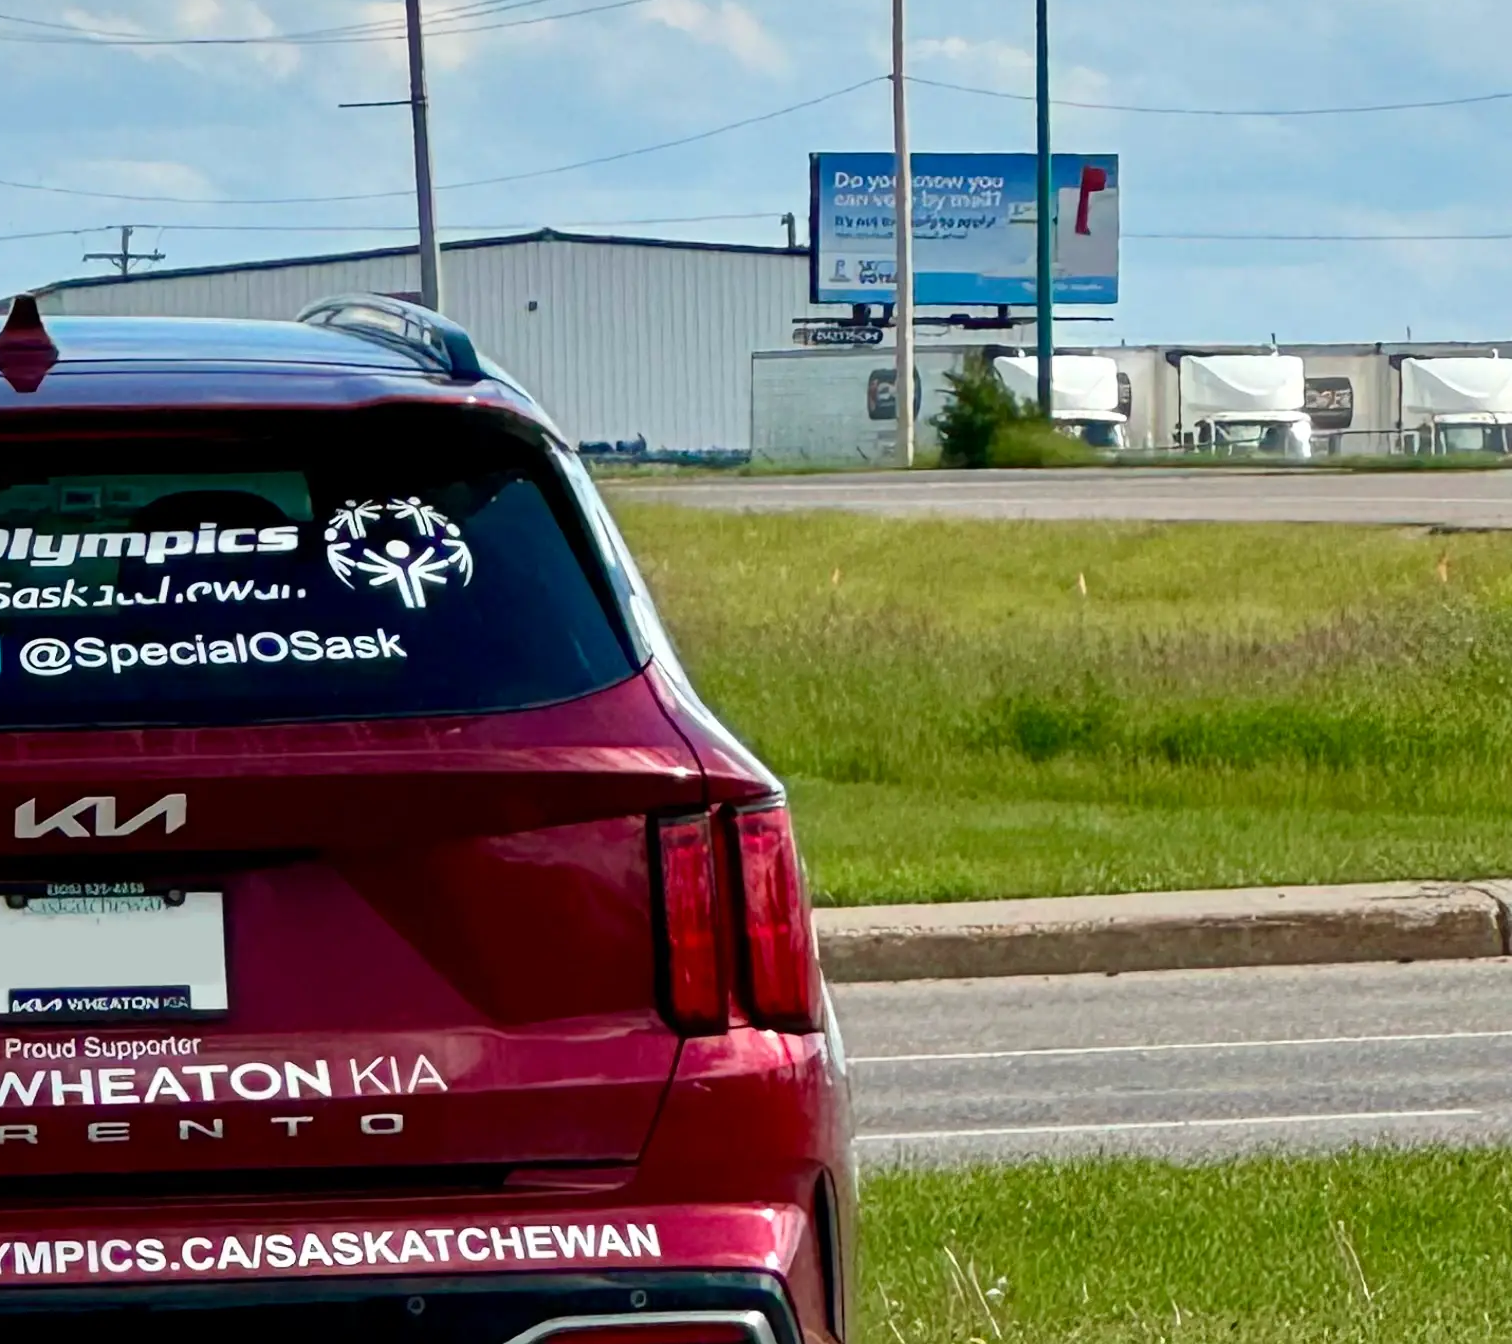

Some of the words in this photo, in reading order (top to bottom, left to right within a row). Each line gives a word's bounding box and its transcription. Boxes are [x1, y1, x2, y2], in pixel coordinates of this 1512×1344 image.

[834, 171, 864, 189] Do
[912, 175, 963, 189] now
[967, 175, 1004, 193] you
[922, 189, 948, 210] by
[18, 627, 409, 676] @SpecialOSask
[14, 793, 187, 839] KIA
[66, 996, 160, 1012] WHEATON
[4, 1037, 77, 1060] Proud
[83, 1035, 203, 1061] Supporter
[350, 1053, 449, 1096] KIA
